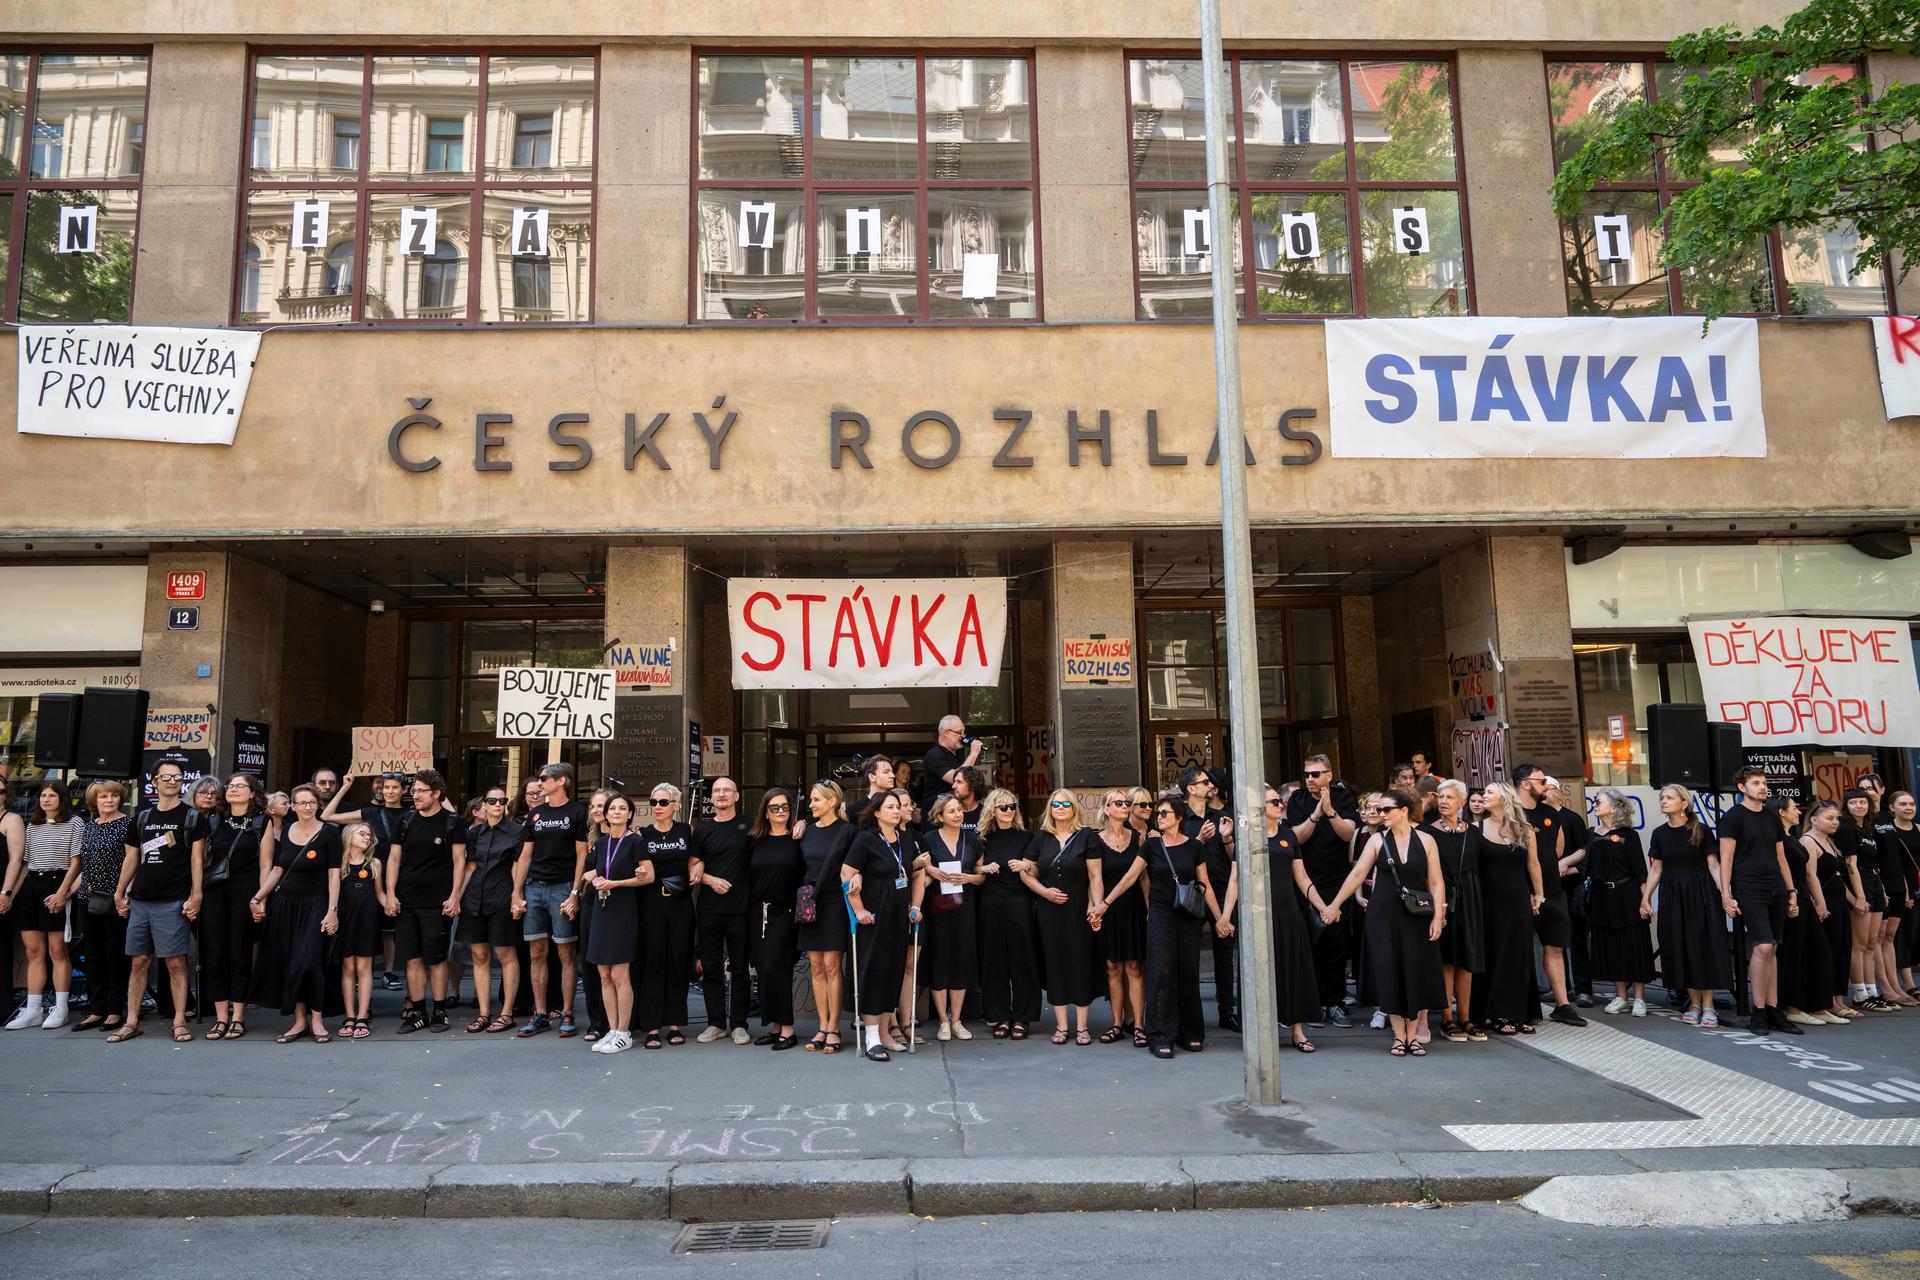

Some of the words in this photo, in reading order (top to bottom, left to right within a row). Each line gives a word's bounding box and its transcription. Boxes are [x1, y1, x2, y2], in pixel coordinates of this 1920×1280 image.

[25, 328, 137, 368] VEŘEJNÁ
[151, 338, 236, 378] SLUŽBA
[1364, 334, 1734, 425] STÁVKA!
[38, 371, 105, 409] PRO
[388, 396, 738, 473] ČESKÝ
[171, 574, 200, 586] 1409
[176, 612, 189, 624] 12
[741, 585, 988, 671] STÁVKA
[1066, 640, 1131, 657] NEZÁVISLÝ
[1704, 622, 1899, 666] DĚKUJEME
[611, 648, 635, 666] NA
[1, 679, 77, 687] www.radioteka.cz
[504, 669, 611, 701] BOJUJEME
[1785, 664, 1832, 698] ZA
[543, 696, 571, 713] ZA
[147, 713, 210, 724] RANSPARENT
[503, 712, 613, 738] ROZHLAS
[1720, 699, 1887, 735] PODPORU
[147, 731, 202, 743] ROZHLAS
[166, 724, 188, 733] PRO
[238, 752, 265, 766] STÁVKA
[1748, 753, 1796, 762] VÝSTRAŽNÁ
[358, 761, 373, 773] VY
